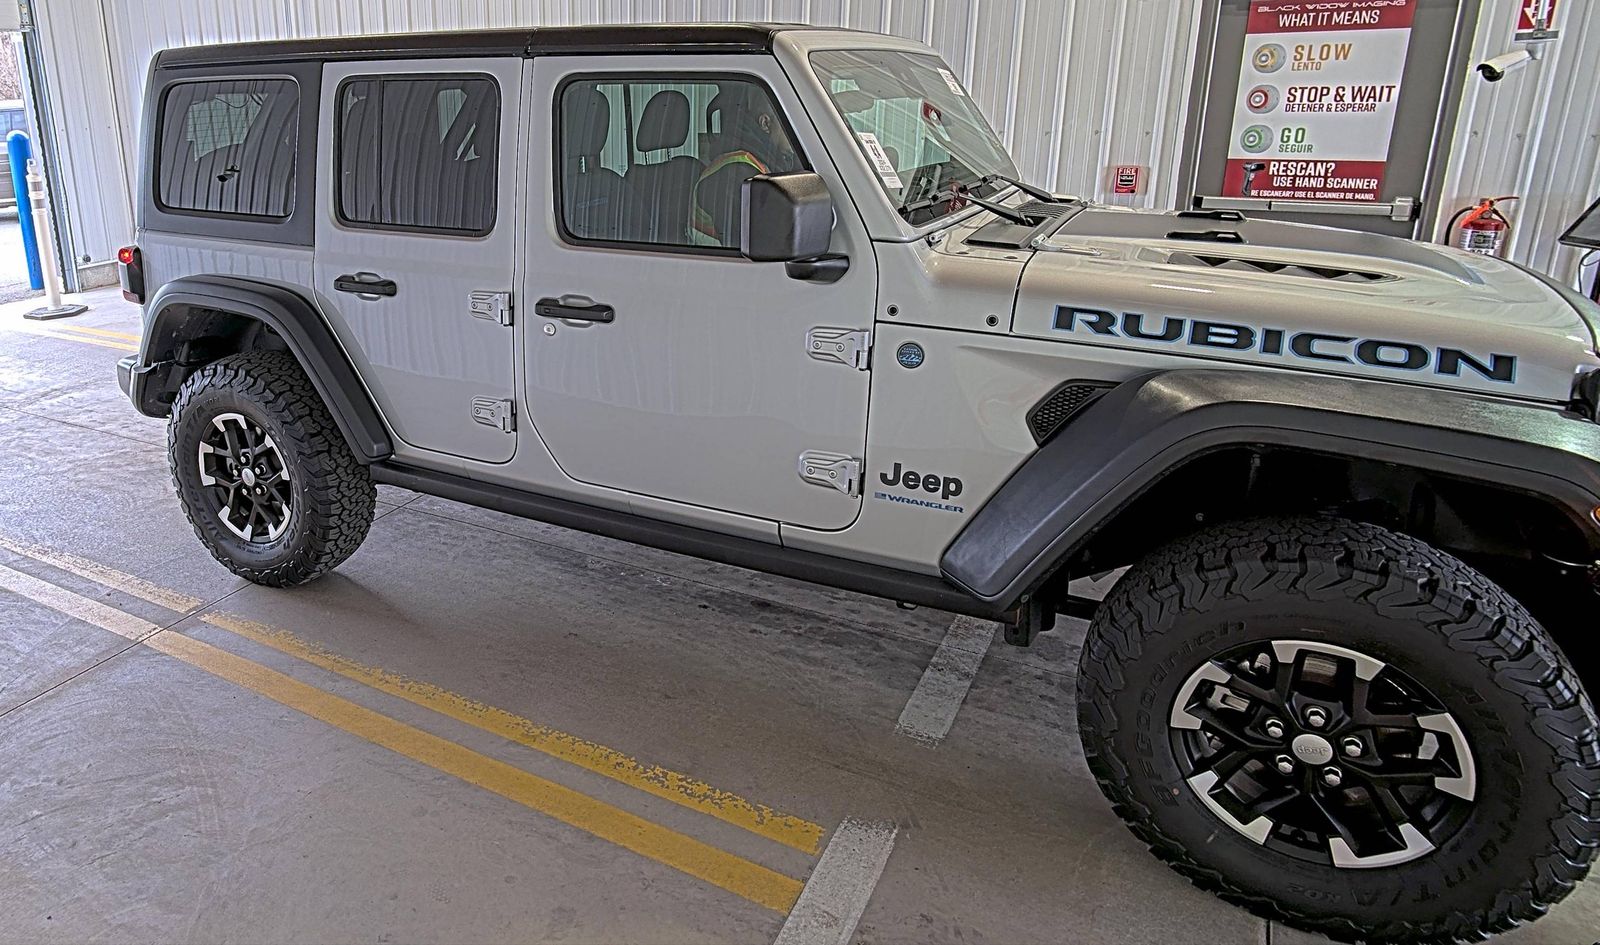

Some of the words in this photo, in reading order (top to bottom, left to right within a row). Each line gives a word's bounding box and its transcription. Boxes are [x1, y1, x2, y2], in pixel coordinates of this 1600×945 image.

[1257, 4, 1301, 13] BLACK
[1352, 0, 1406, 8] IMAGING
[1279, 12, 1316, 28] WHAT
[1317, 11, 1331, 26] IT
[1331, 9, 1380, 26] MEANS
[1293, 43, 1353, 62] SLOW
[1291, 61, 1322, 72] LENTO
[1286, 86, 1330, 103] STOP
[1334, 86, 1346, 102] &
[1351, 85, 1396, 103] WAIT
[1284, 103, 1325, 113] DETENER
[1325, 103, 1332, 113] &
[1334, 103, 1377, 113] ESPERAR
[1280, 127, 1306, 144] GO
[1278, 143, 1314, 154] SEGUIR
[1269, 161, 1336, 177] RESCAN?
[1272, 177, 1293, 188] USE
[1295, 177, 1325, 189] HAND
[1326, 177, 1378, 190] SCANNER
[1250, 189, 1259, 197] RE
[1259, 189, 1294, 198] ESCANEAR?
[1294, 190, 1307, 198] USE
[1307, 191, 1315, 199] EL
[1315, 191, 1344, 200] SCANNER
[1344, 192, 1353, 200] DE
[1050, 303, 1519, 384] RUBICON
[879, 462, 963, 500] Jeep
[887, 494, 965, 514] WRANGLER
